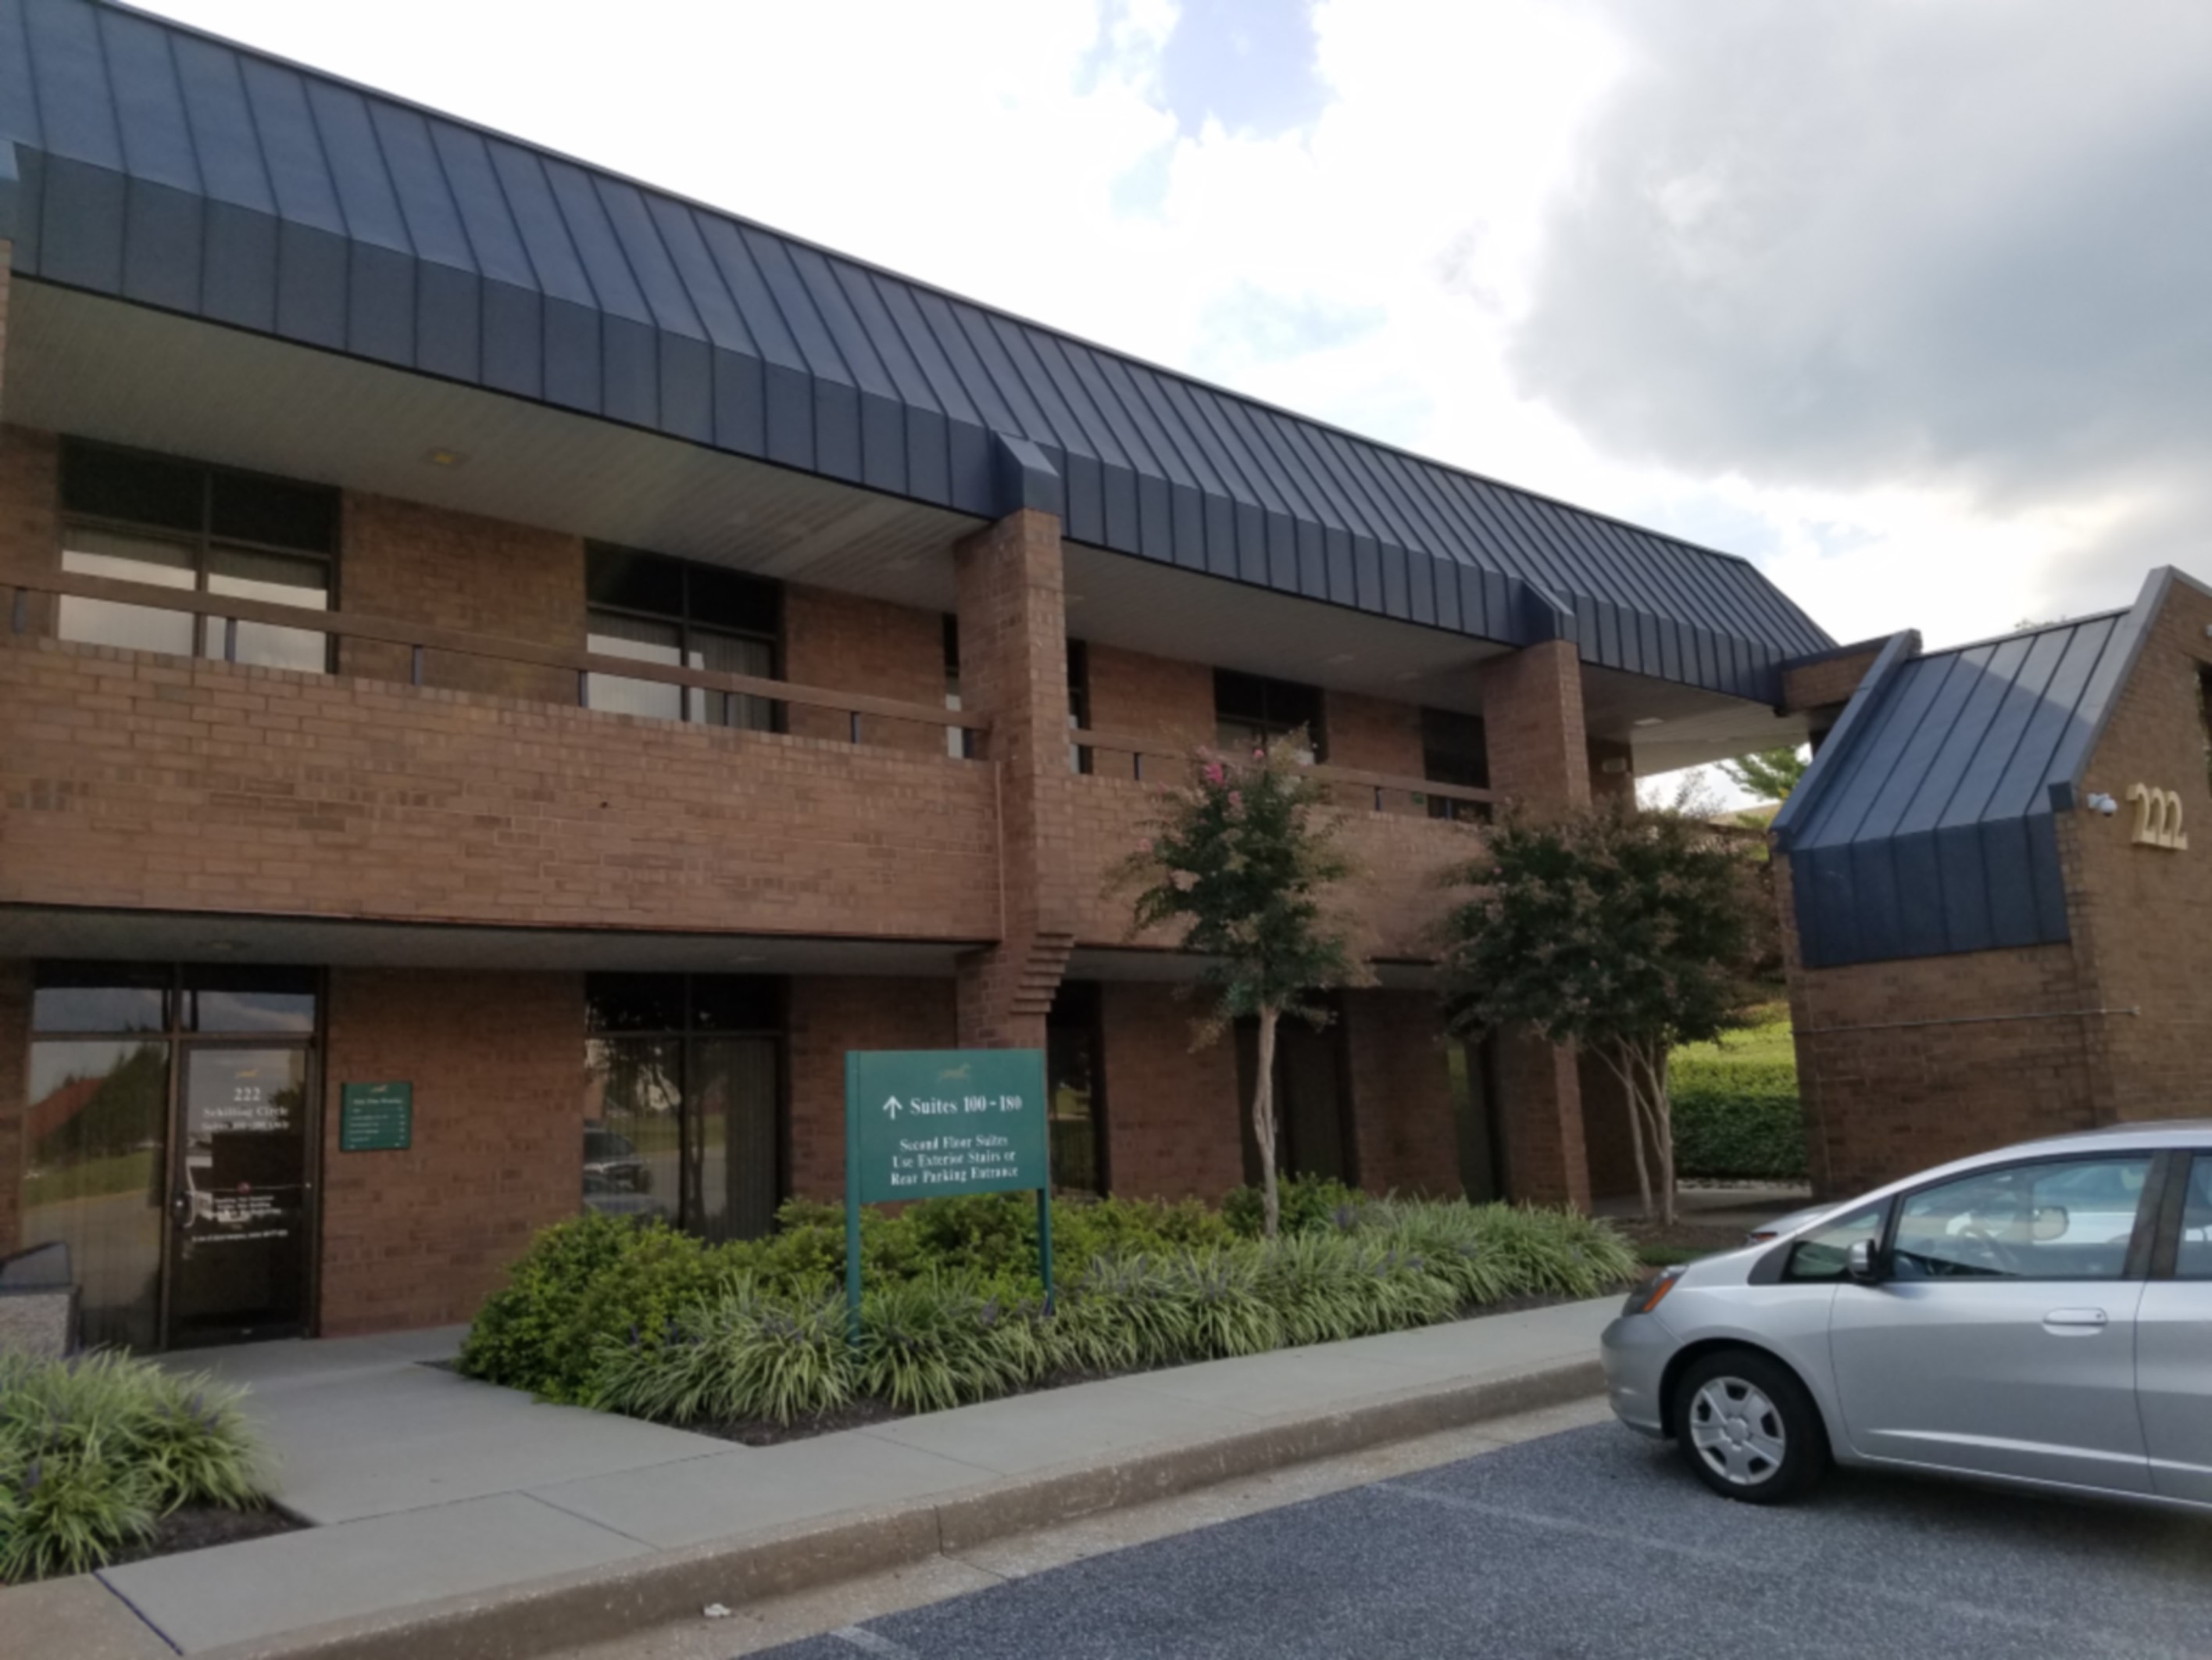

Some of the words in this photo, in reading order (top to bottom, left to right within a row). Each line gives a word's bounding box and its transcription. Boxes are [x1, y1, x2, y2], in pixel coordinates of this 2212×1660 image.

[2125, 782, 2188, 850] 222
[233, 1086, 261, 1102] 222
[256, 1106, 288, 1117] Circle
[909, 1097, 958, 1115] Suites
[900, 1136, 938, 1151] Second
[943, 1136, 973, 1149] Floor
[976, 1134, 1008, 1147] Suites
[893, 1154, 913, 1168] Use
[917, 1153, 963, 1168] Exterior
[967, 1150, 1001, 1164] Stairs
[1003, 1151, 1016, 1162] or
[891, 1172, 918, 1186] Rear
[923, 1169, 967, 1183] Parking
[971, 1167, 1019, 1180] Entrance
